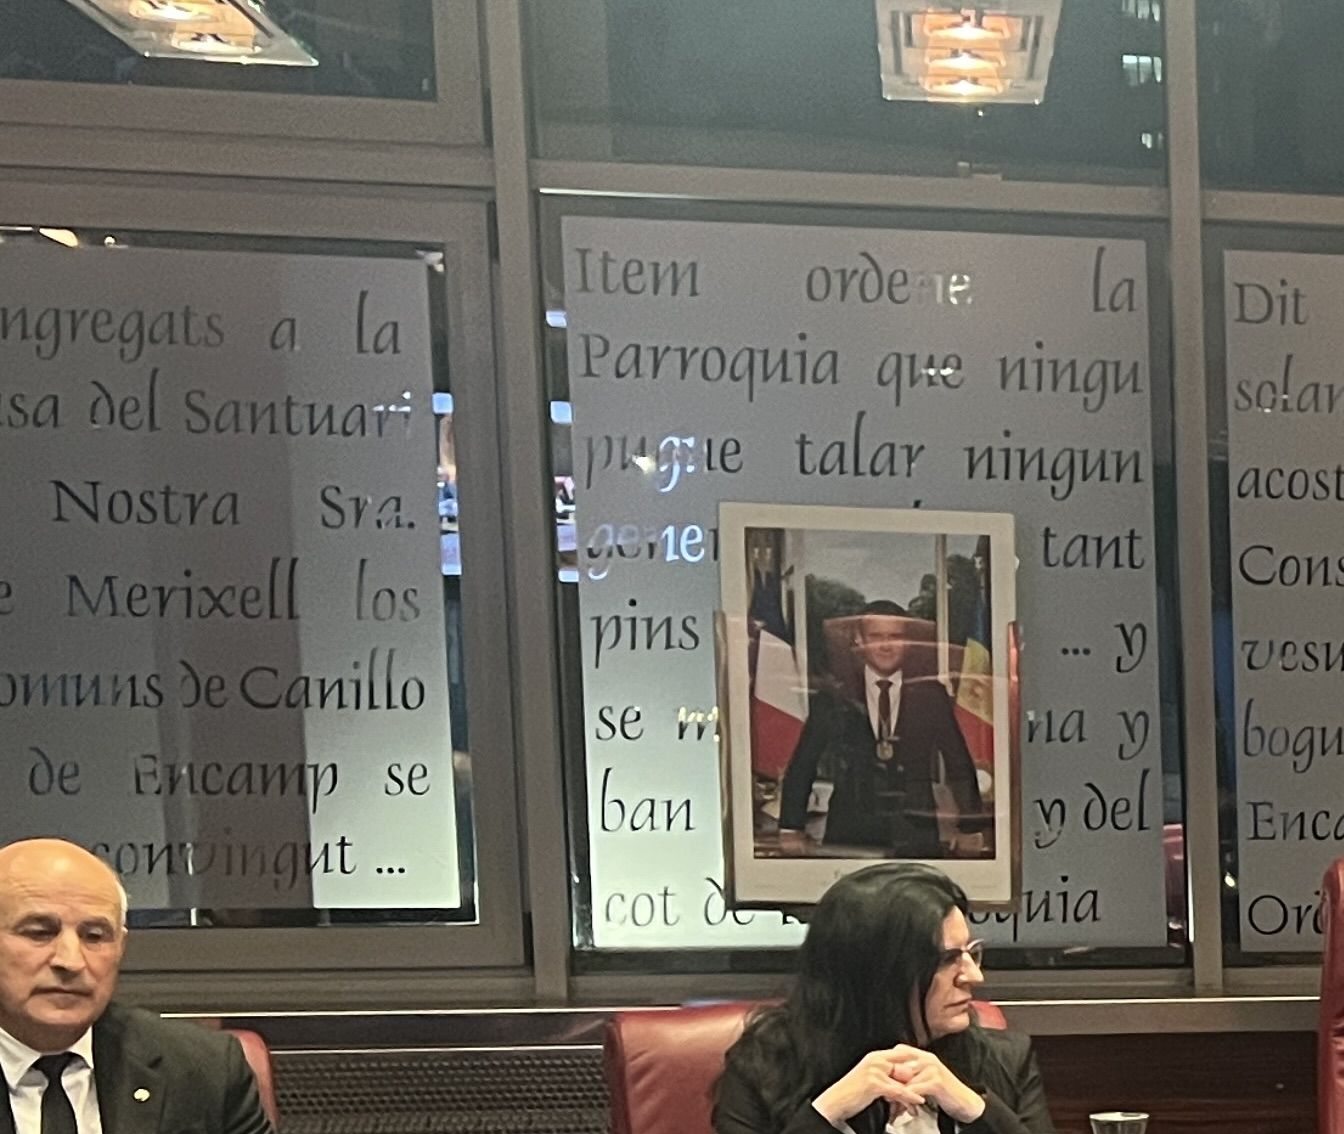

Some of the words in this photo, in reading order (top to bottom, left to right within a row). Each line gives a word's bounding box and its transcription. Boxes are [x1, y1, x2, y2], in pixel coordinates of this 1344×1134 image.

[574, 247, 701, 299] Item
[1092, 246, 1137, 313] la
[1234, 278, 1310, 327] Dit
[270, 314, 297, 352] a
[357, 290, 401, 355] la
[0, 393, 62, 429] sa
[90, 367, 161, 432] del
[577, 332, 840, 402] Parroquia
[876, 351, 965, 408] que
[999, 340, 1145, 414] ningu
[795, 411, 925, 479] talar
[963, 430, 1146, 501] ningun
[51, 480, 241, 528] Nostra
[320, 484, 416, 530] Sra.
[1042, 525, 1146, 571] tant
[66, 556, 300, 621] Merixell
[357, 560, 421, 624] los
[589, 600, 701, 669] pins
[1114, 622, 1147, 673] y
[178, 659, 229, 709] de
[240, 648, 426, 712] Canillo
[595, 705, 644, 742] se
[1117, 710, 1149, 761] y
[28, 748, 81, 797] de
[132, 754, 339, 815] Encamp
[384, 762, 431, 797] se
[600, 767, 696, 833] ban
[1033, 797, 1067, 849] y
[1083, 768, 1150, 831] del
[604, 886, 680, 927] cot
